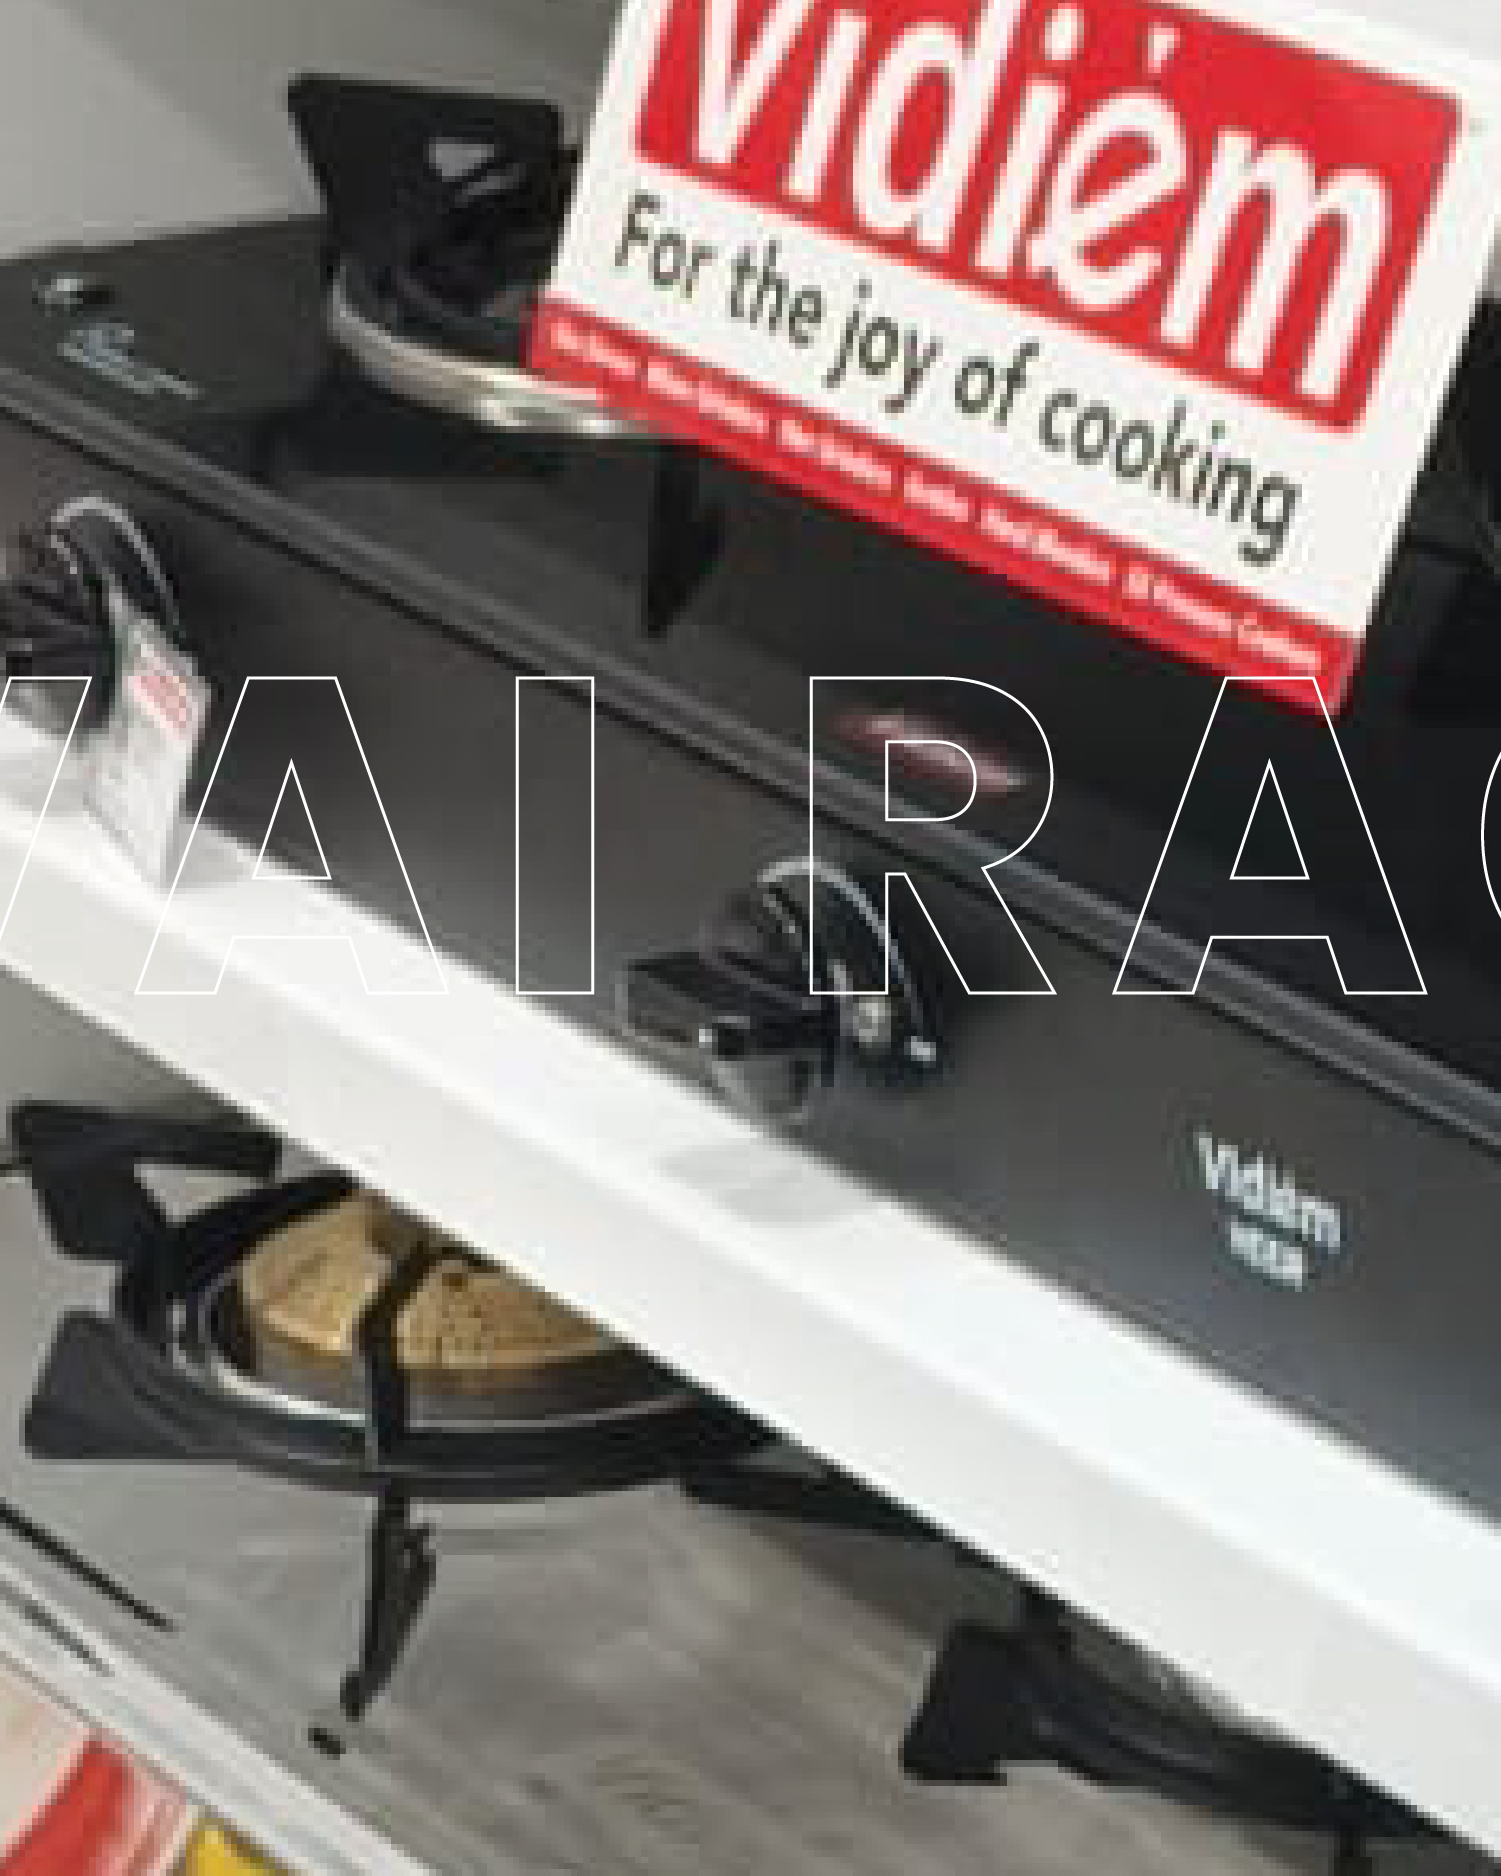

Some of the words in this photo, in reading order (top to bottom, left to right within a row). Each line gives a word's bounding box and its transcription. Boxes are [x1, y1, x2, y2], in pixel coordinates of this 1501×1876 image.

[614, 192, 716, 299] For
[729, 237, 824, 349] the
[822, 278, 944, 414] joy
[954, 337, 1040, 427] of
[1038, 395, 1303, 567] cooking
